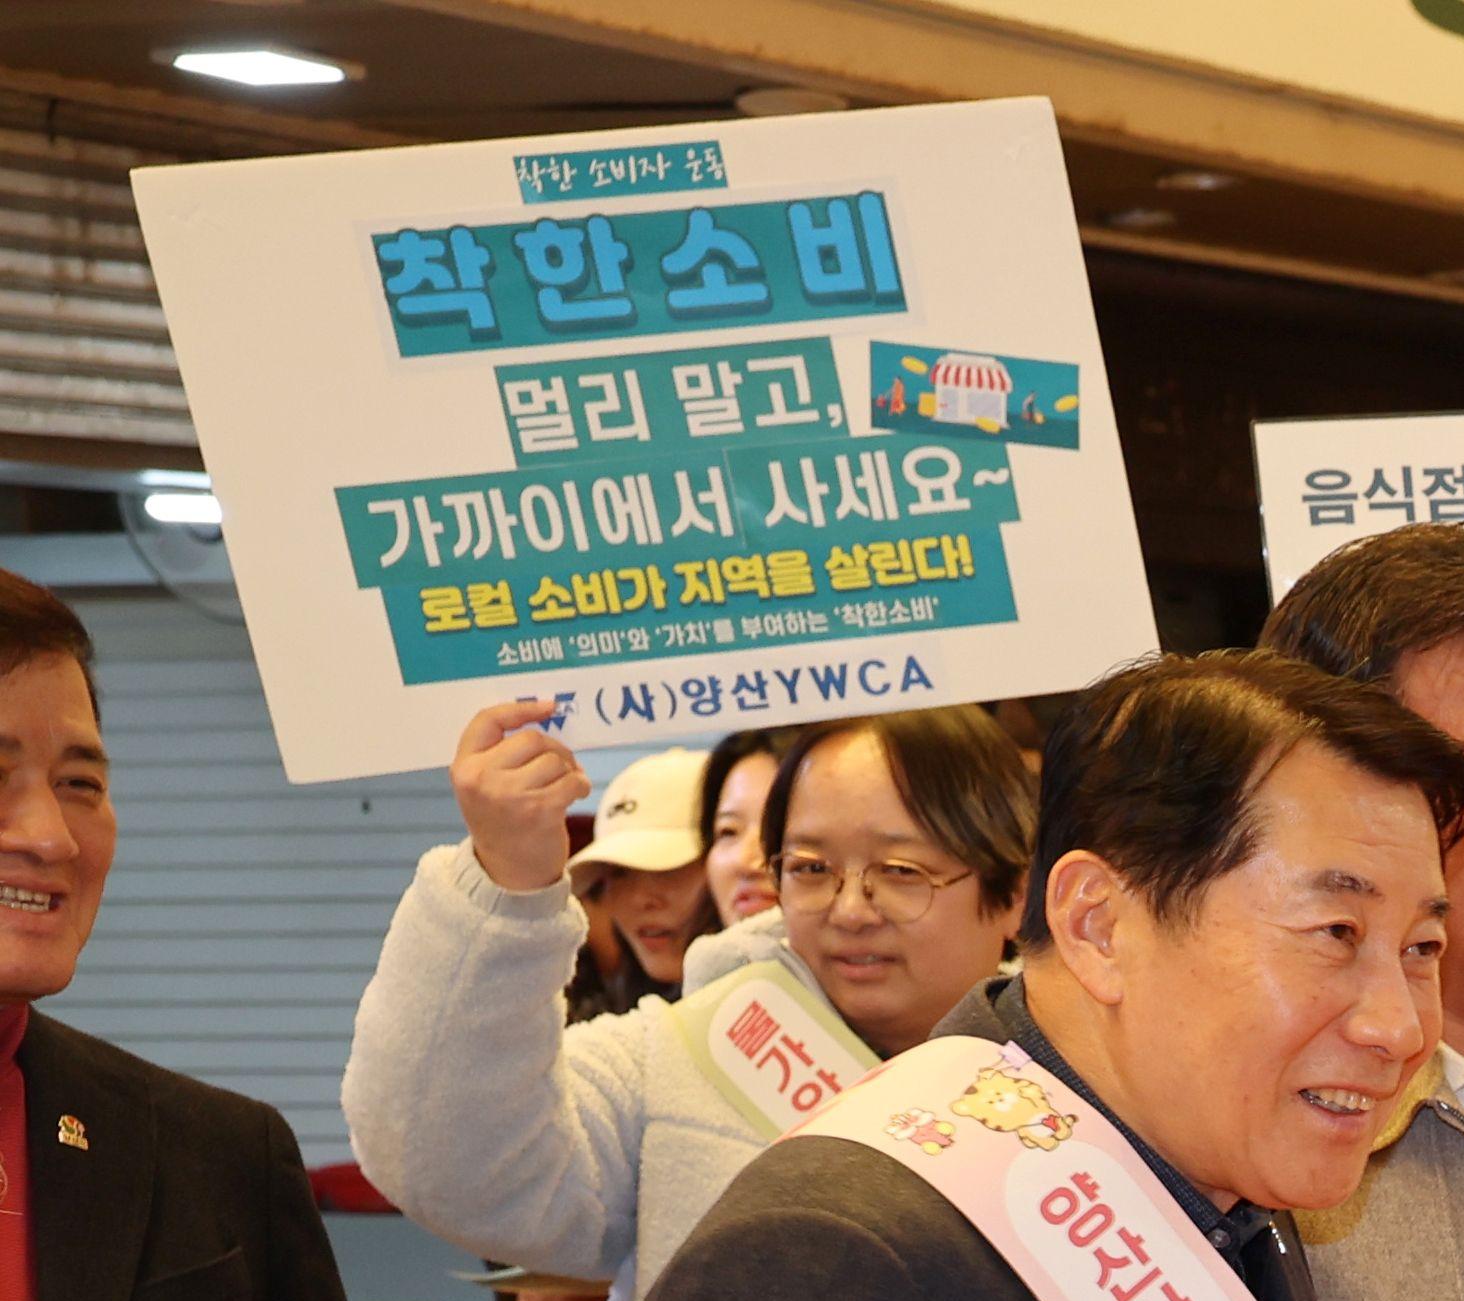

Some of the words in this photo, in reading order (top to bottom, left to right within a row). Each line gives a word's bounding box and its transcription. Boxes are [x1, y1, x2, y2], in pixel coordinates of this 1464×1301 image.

[518, 155, 577, 195] 착한
[589, 152, 672, 187] 소비자
[683, 147, 728, 184] 운동
[504, 368, 652, 453] 멀리
[672, 354, 843, 437] 말고,
[366, 466, 737, 568] 가까이에서
[765, 446, 1012, 529] 사세요~
[419, 583, 520, 634] 로컬
[529, 569, 668, 622] 소비가
[674, 550, 814, 605] 지역을
[825, 534, 976, 592] 살린다!
[496, 634, 565, 666] 소비에
[741, 608, 829, 639] 부여하는
[594, 653, 935, 726] (사)양산YWCA
